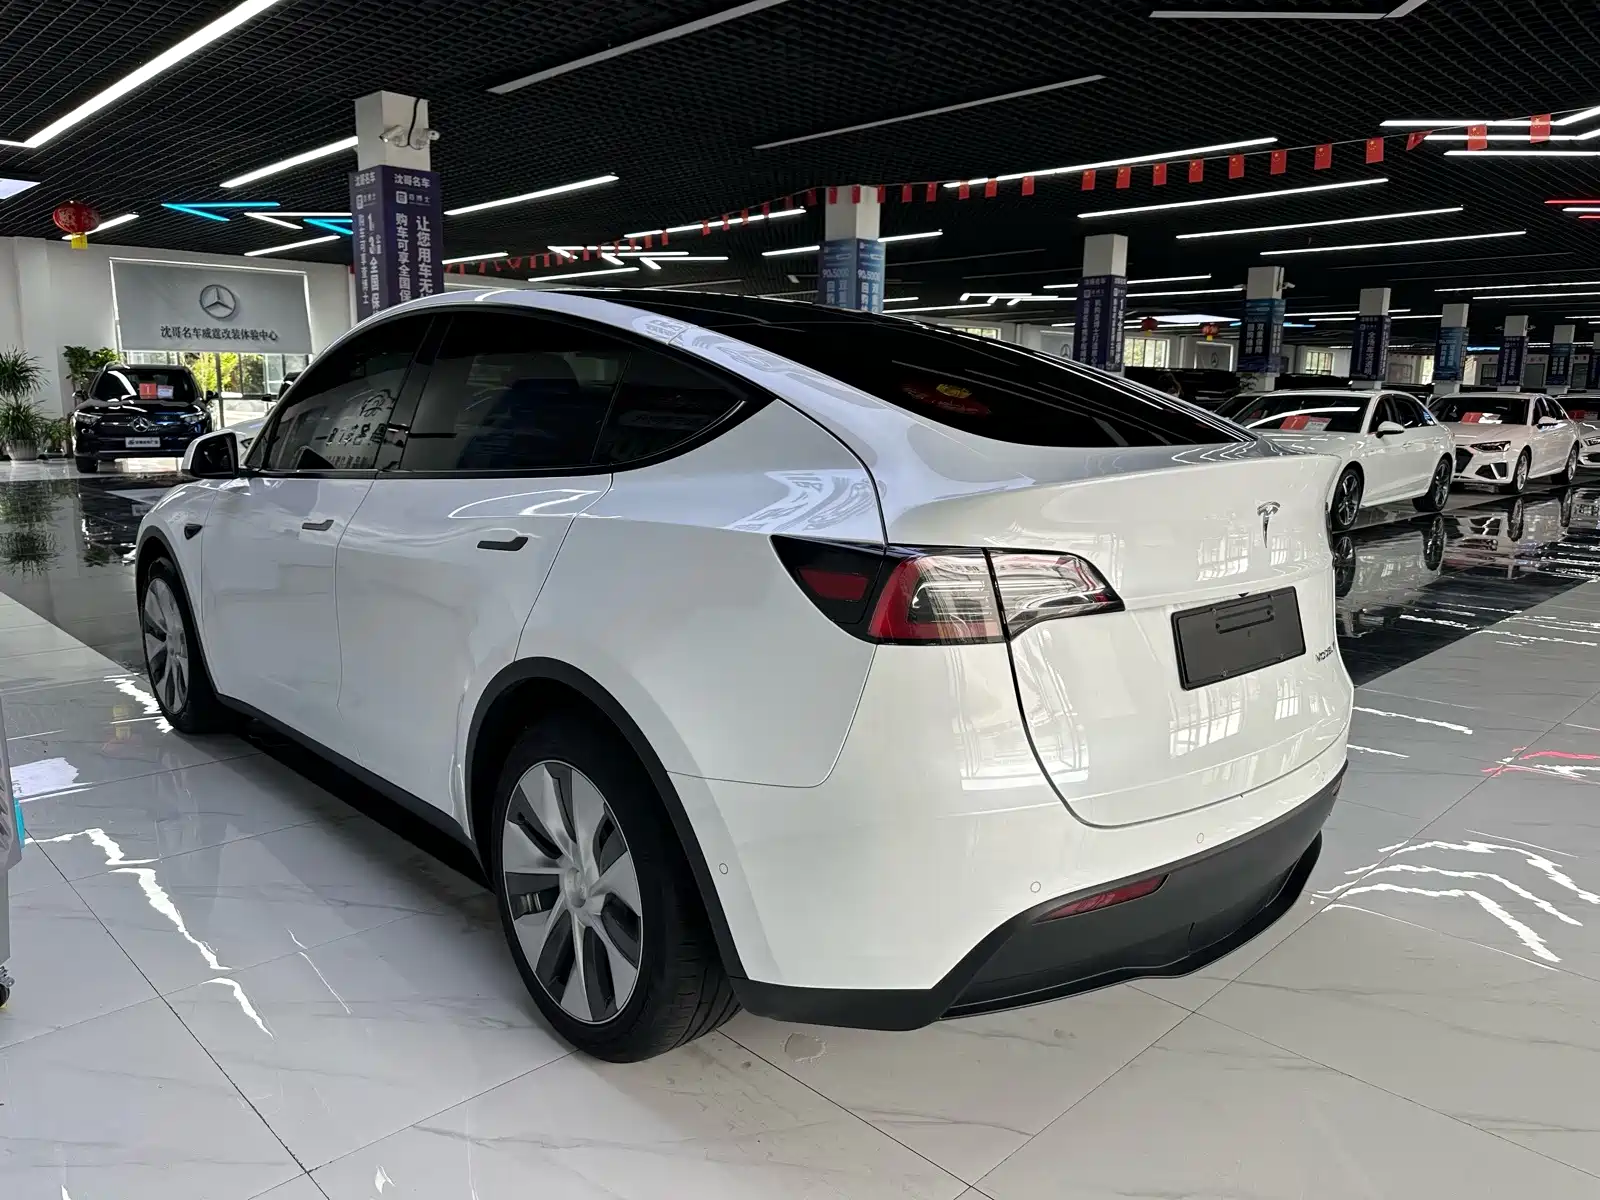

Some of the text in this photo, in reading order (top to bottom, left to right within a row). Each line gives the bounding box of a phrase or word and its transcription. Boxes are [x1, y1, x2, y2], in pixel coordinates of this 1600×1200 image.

[394, 173, 431, 189] 沈哥名车
[160, 325, 279, 342] 沈哥名车威霆改装体验中心
